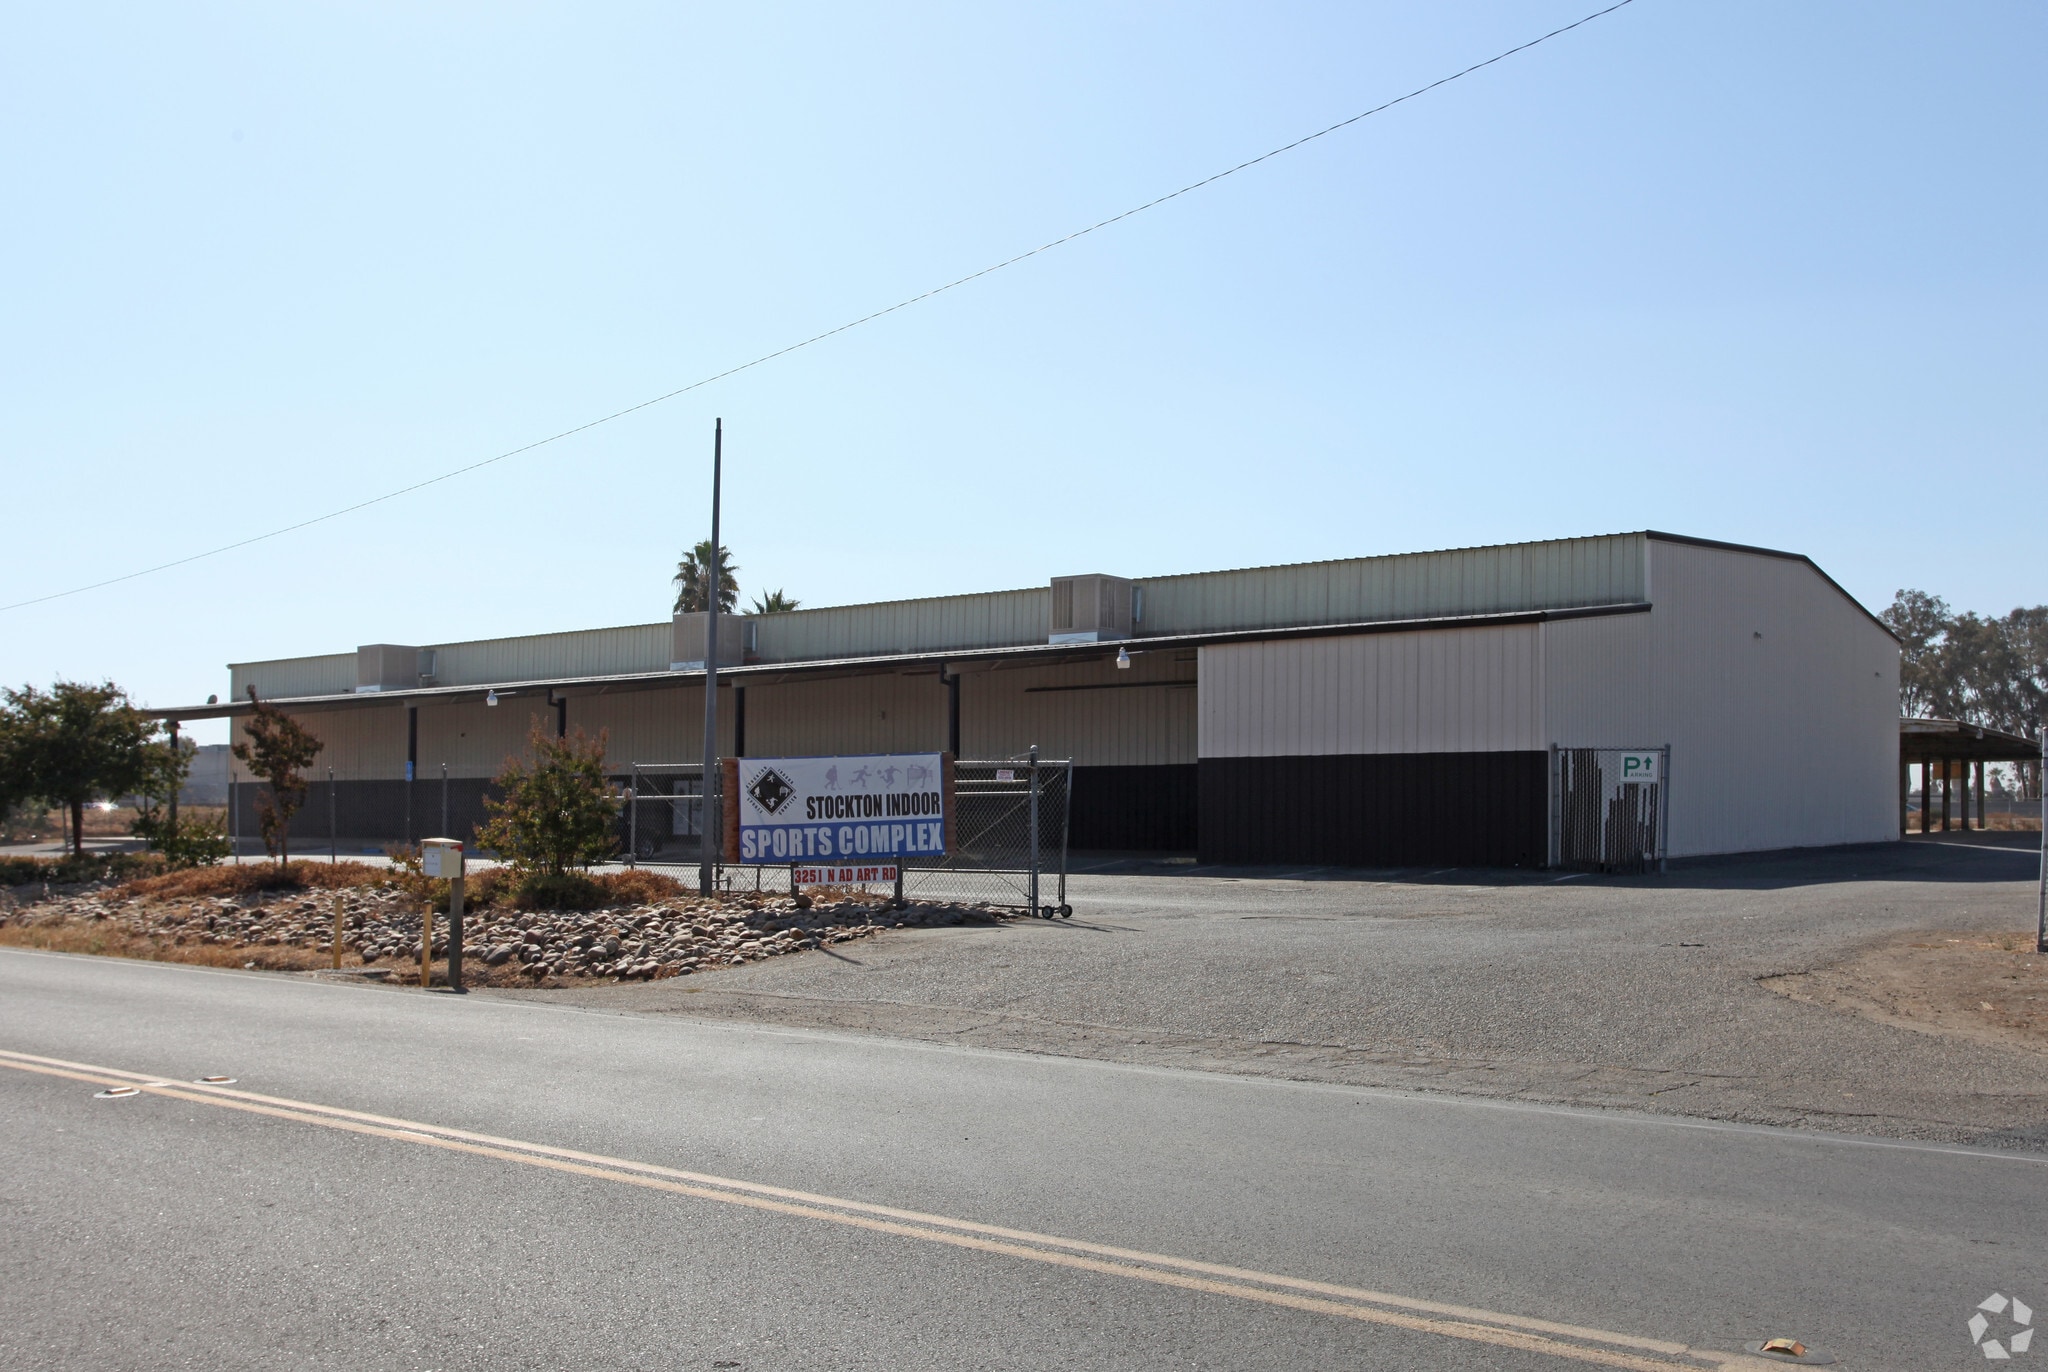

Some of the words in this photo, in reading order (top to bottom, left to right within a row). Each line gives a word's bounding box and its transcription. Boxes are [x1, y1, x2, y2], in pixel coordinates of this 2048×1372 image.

[806, 794, 882, 820] STOCKTON
[886, 792, 941, 816] INDOOR
[742, 827, 833, 858] SPORTS
[838, 822, 943, 855] COMPLEX
[795, 869, 822, 884] 3251
[827, 869, 835, 882] N
[839, 868, 853, 882] AD
[856, 867, 879, 882] ART
[882, 866, 897, 881] RD
